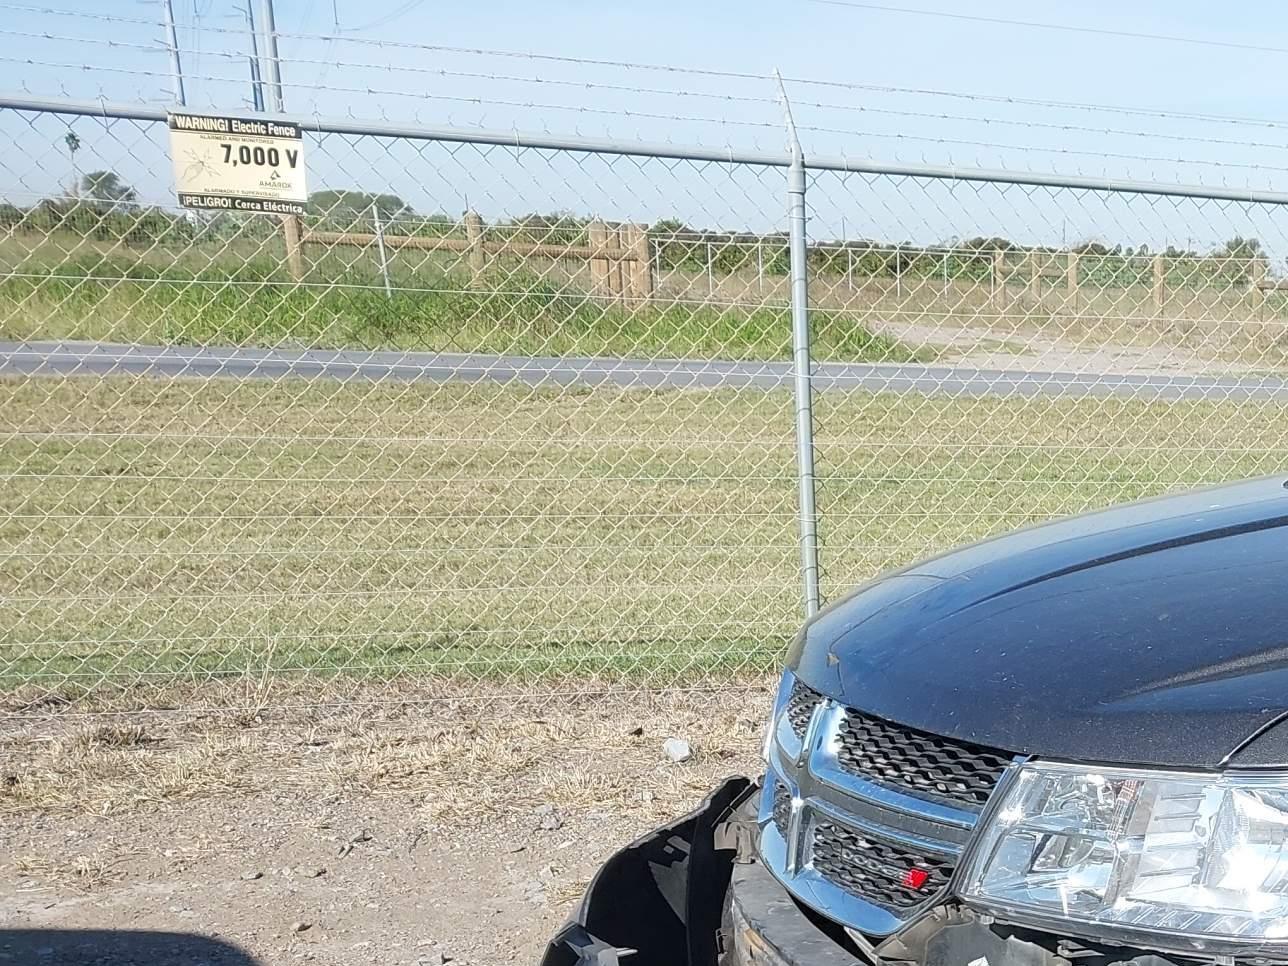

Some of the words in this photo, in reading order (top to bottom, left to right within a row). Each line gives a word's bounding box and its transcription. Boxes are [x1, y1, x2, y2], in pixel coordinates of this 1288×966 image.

[175, 115, 229, 131] WARNING!
[232, 120, 266, 134] Electric
[268, 122, 296, 136] Fence
[220, 143, 280, 167] 7,000
[285, 149, 298, 169] V
[183, 195, 232, 208] ¡PELIGRO!
[235, 200, 261, 210] Cerca
[263, 200, 304, 214] Eléctrica
